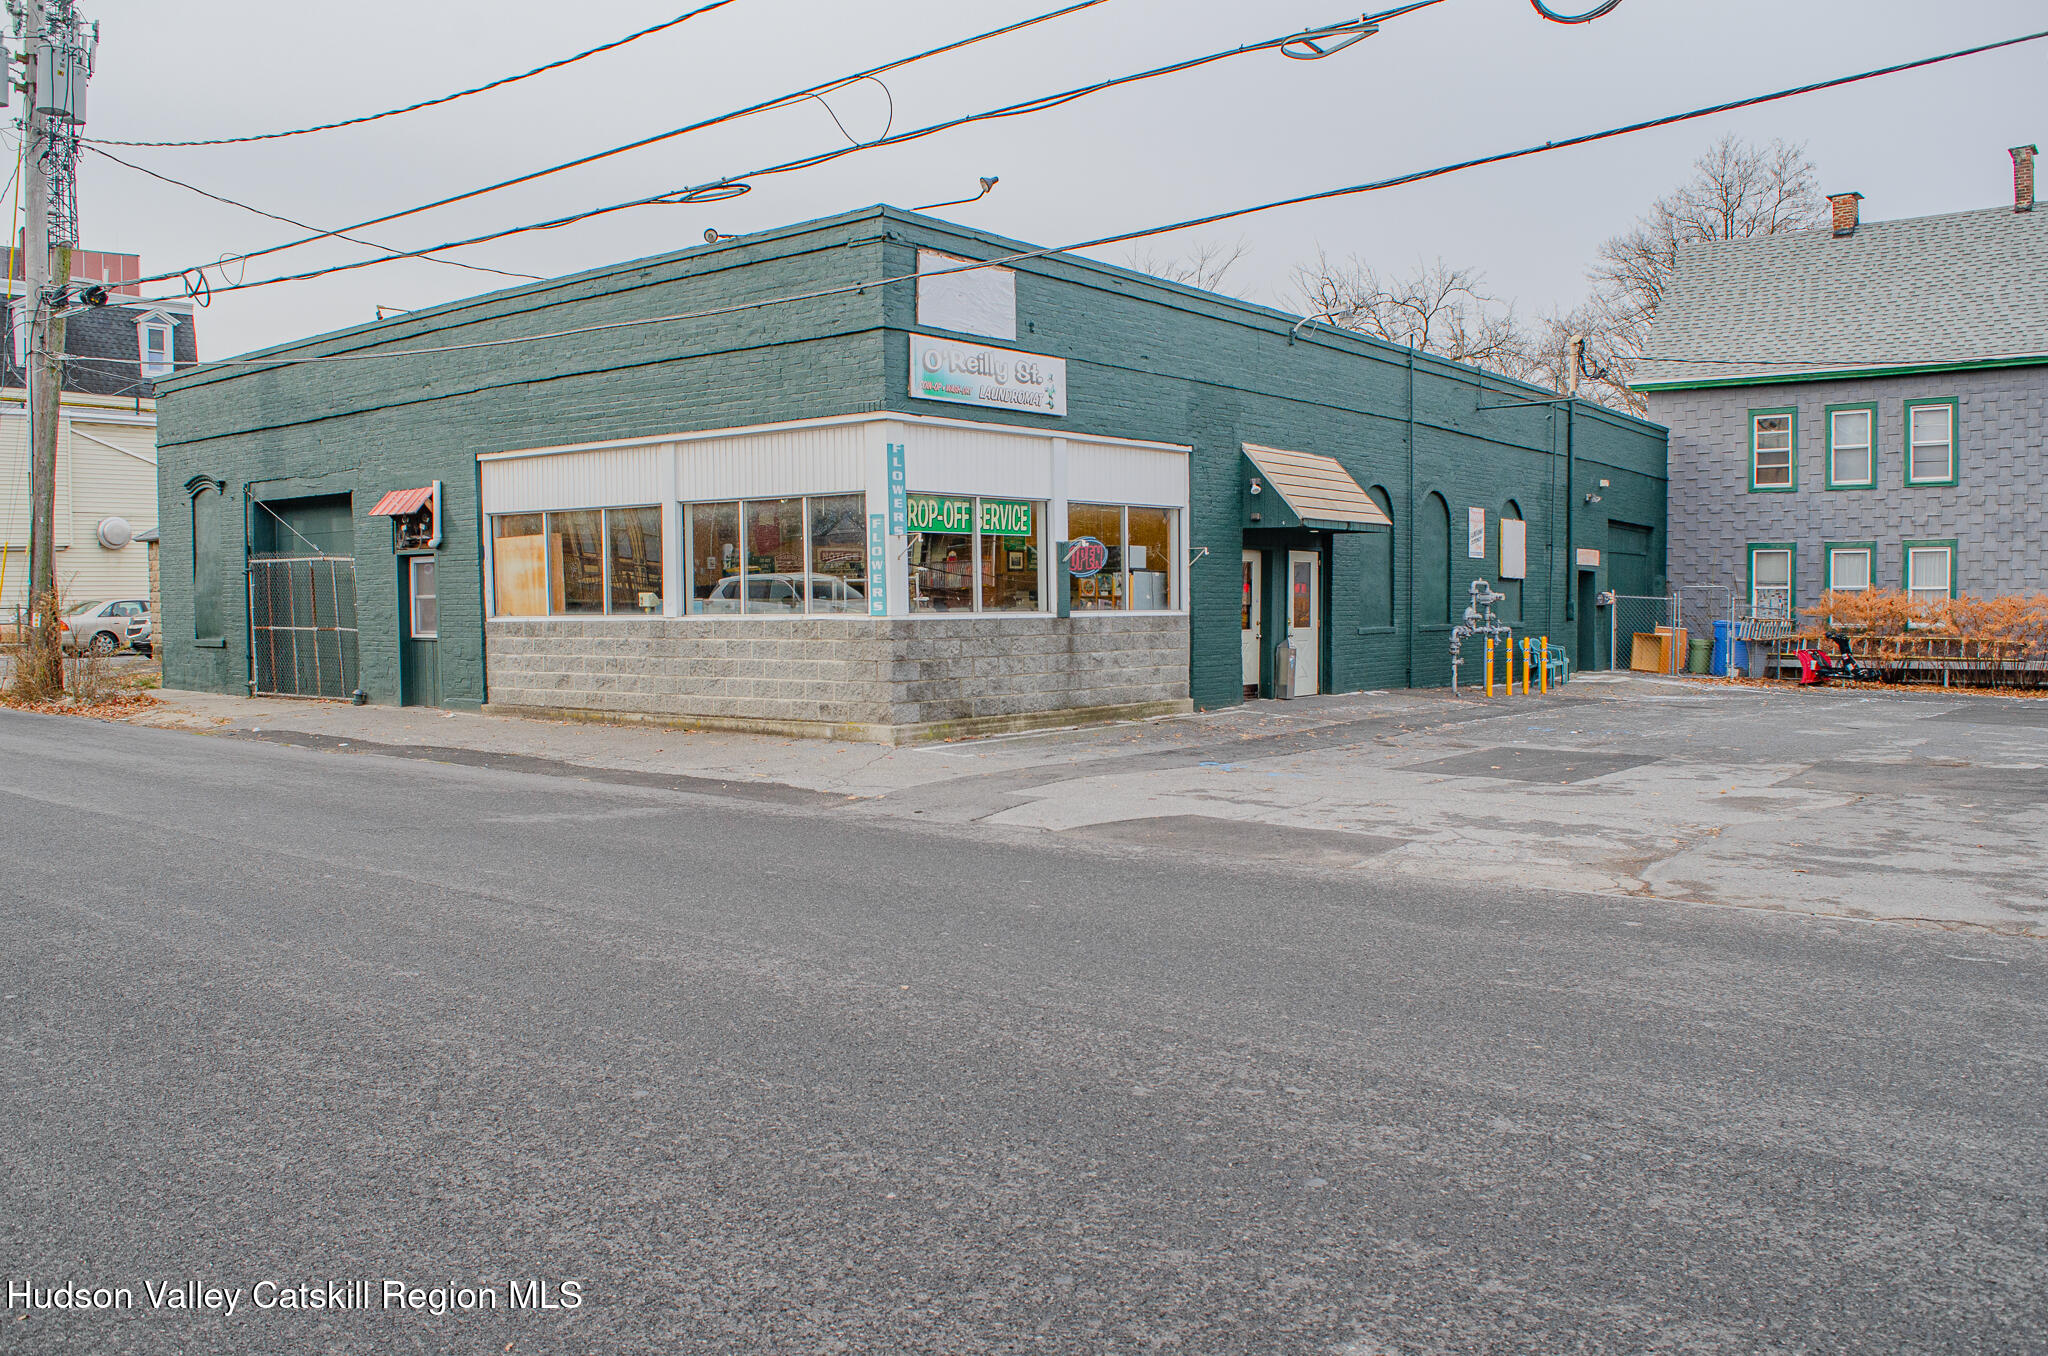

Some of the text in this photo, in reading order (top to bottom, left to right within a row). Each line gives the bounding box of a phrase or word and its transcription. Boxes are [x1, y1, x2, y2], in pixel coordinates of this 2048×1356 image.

[922, 349, 1044, 385] O'Reilly St.
[978, 384, 1045, 408] LAUNDROMAT
[892, 443, 904, 536] FLOWERS
[907, 497, 970, 529] ROP-OFF
[871, 518, 884, 612] FLOWERS
[1069, 545, 1103, 571] OPEN
